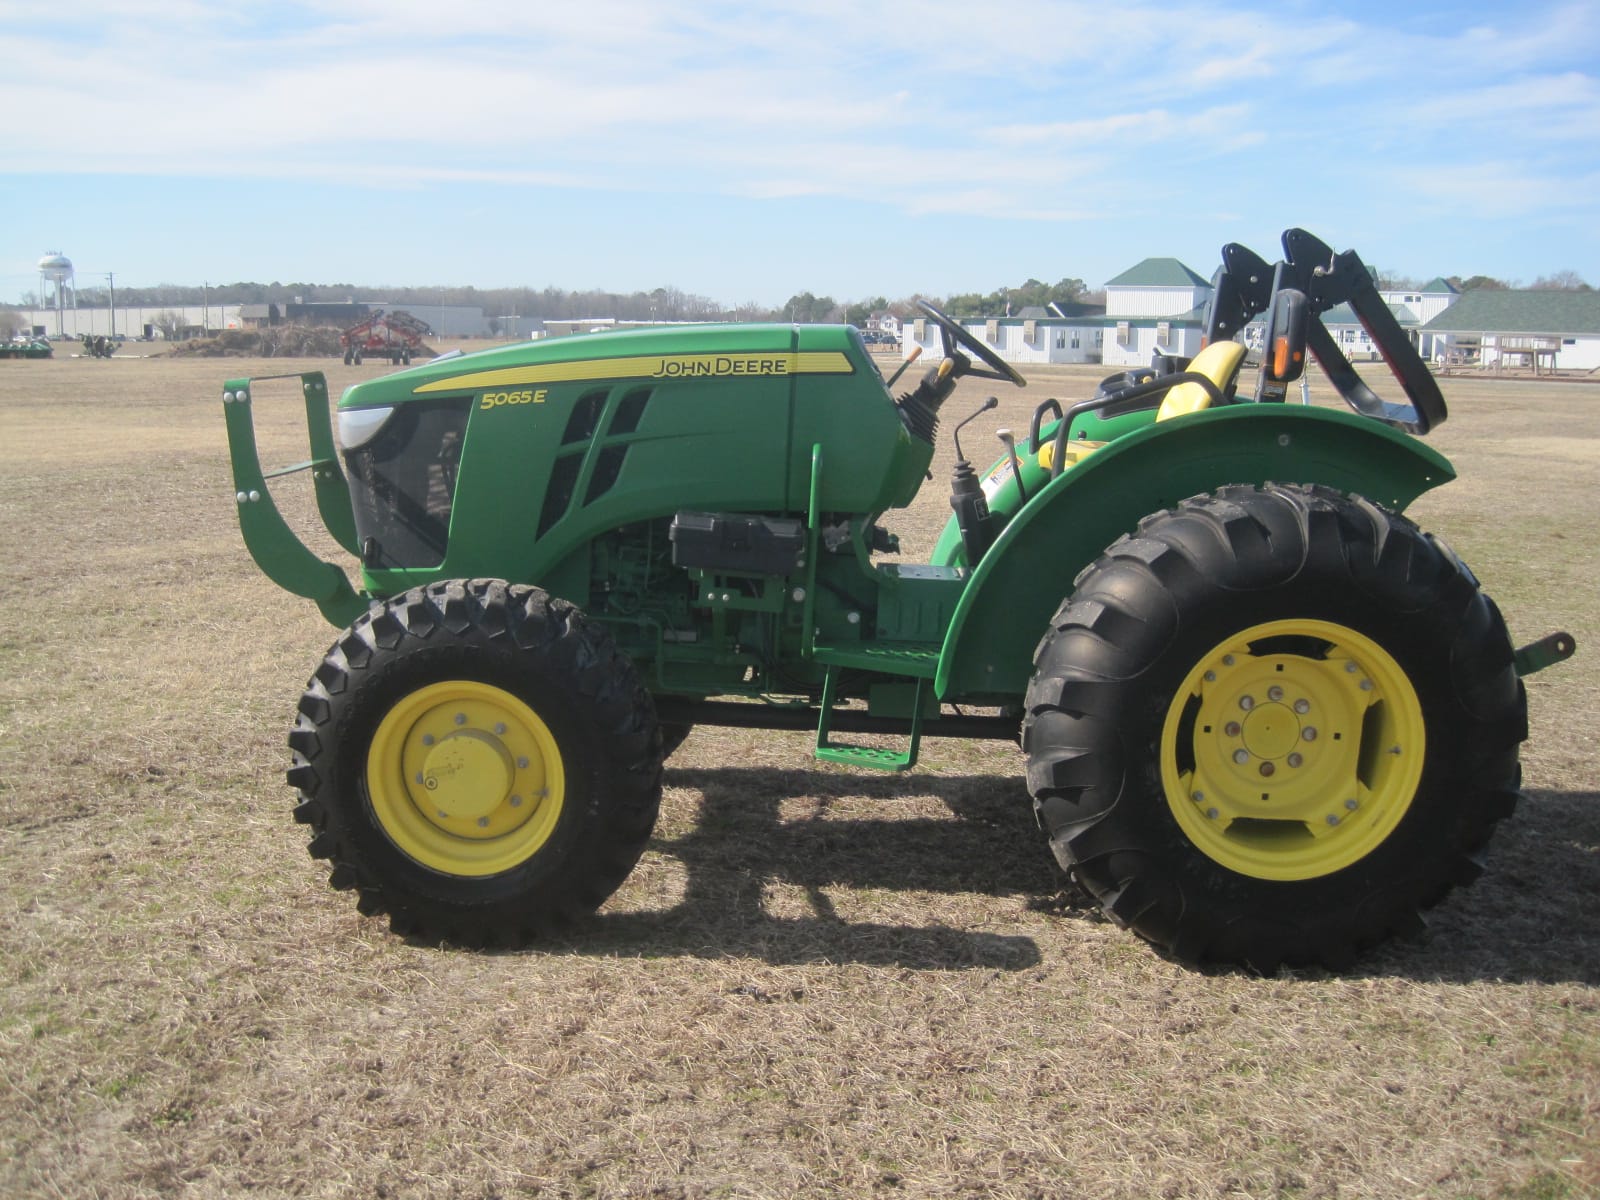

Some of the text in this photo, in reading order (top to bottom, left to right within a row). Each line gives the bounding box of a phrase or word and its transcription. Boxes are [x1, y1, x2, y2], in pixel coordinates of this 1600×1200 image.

[653, 357, 788, 376] JOHN DEERE
[480, 389, 548, 410] 5065E
